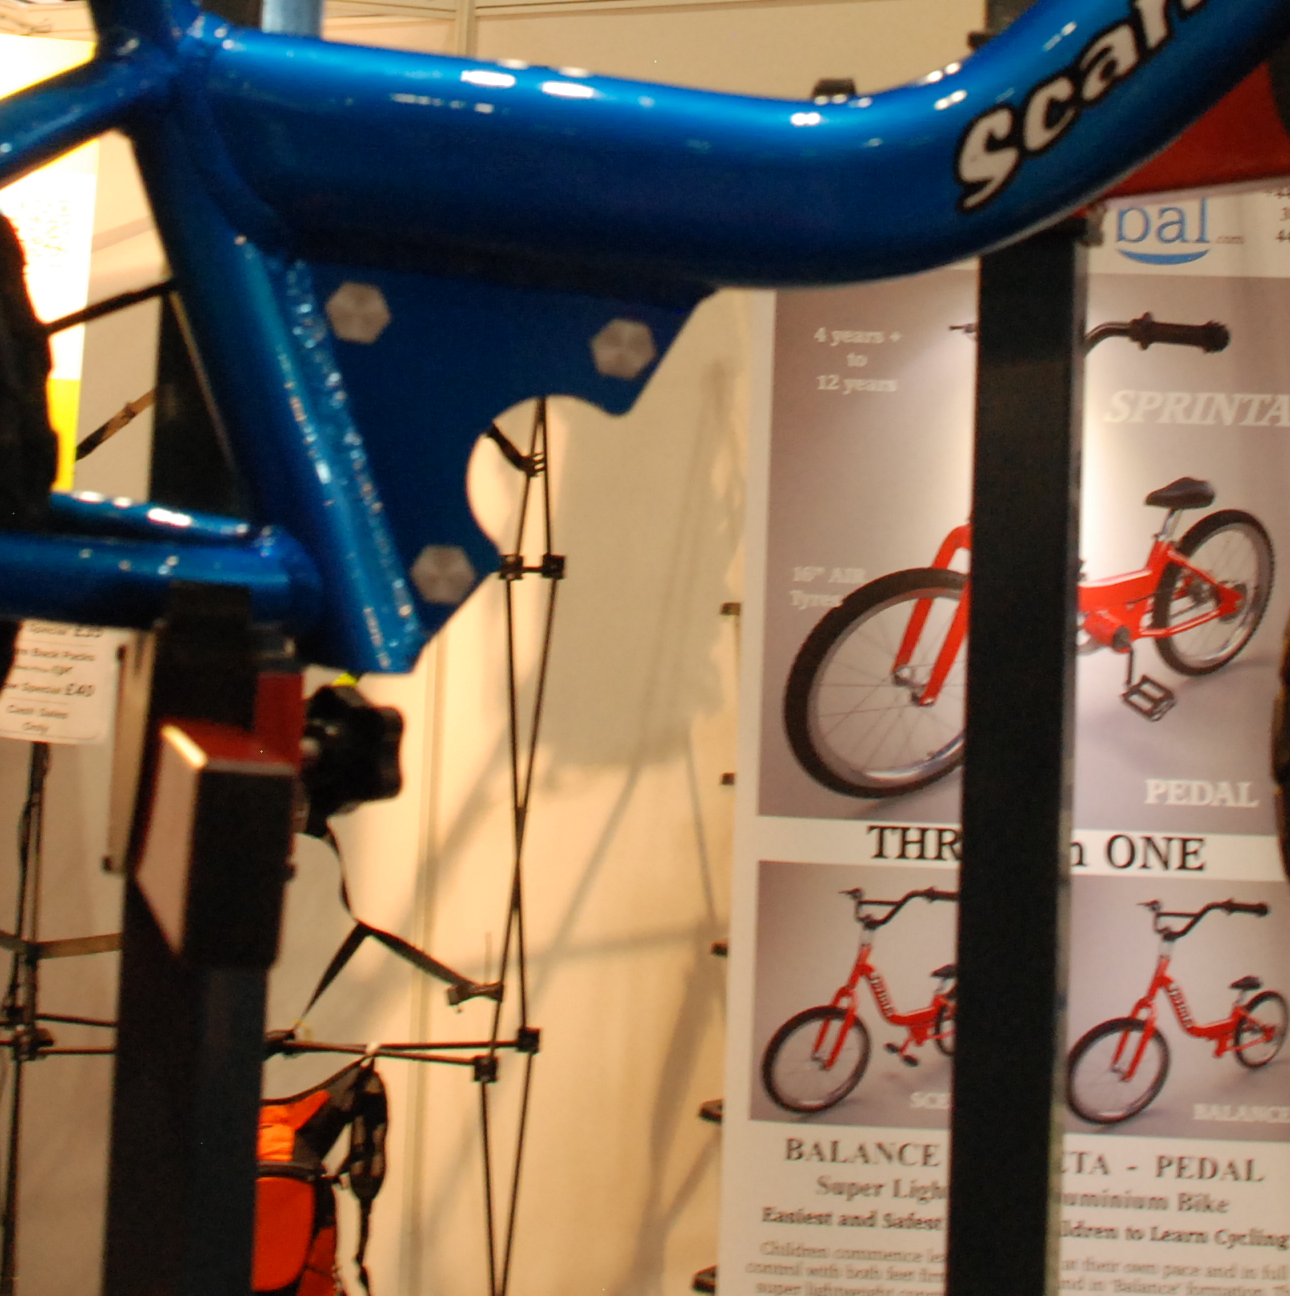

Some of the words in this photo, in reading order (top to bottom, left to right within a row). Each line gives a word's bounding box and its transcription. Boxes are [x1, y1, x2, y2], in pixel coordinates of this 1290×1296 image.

[813, 327, 827, 343] 4
[830, 330, 885, 346] years
[846, 353, 868, 367] to
[816, 374, 840, 391] 12
[842, 378, 898, 395] years
[1145, 779, 1258, 808] PEDAL
[867, 825, 961, 861] THR
[1105, 834, 1206, 872] ONE
[785, 1137, 941, 1167] BALANCE
[1155, 1155, 1265, 1183] PEDAL
[816, 1174, 886, 1201] Super
[1062, 1189, 1169, 1211] uminium
[1177, 1192, 1231, 1214] Bike
[762, 1206, 834, 1227] Easiest
[838, 1209, 878, 1228] and
[882, 1212, 943, 1231] Safest
[1124, 1225, 1143, 1241] to
[1150, 1226, 1209, 1245] Learn
[1213, 1228, 1290, 1251] Cycling
